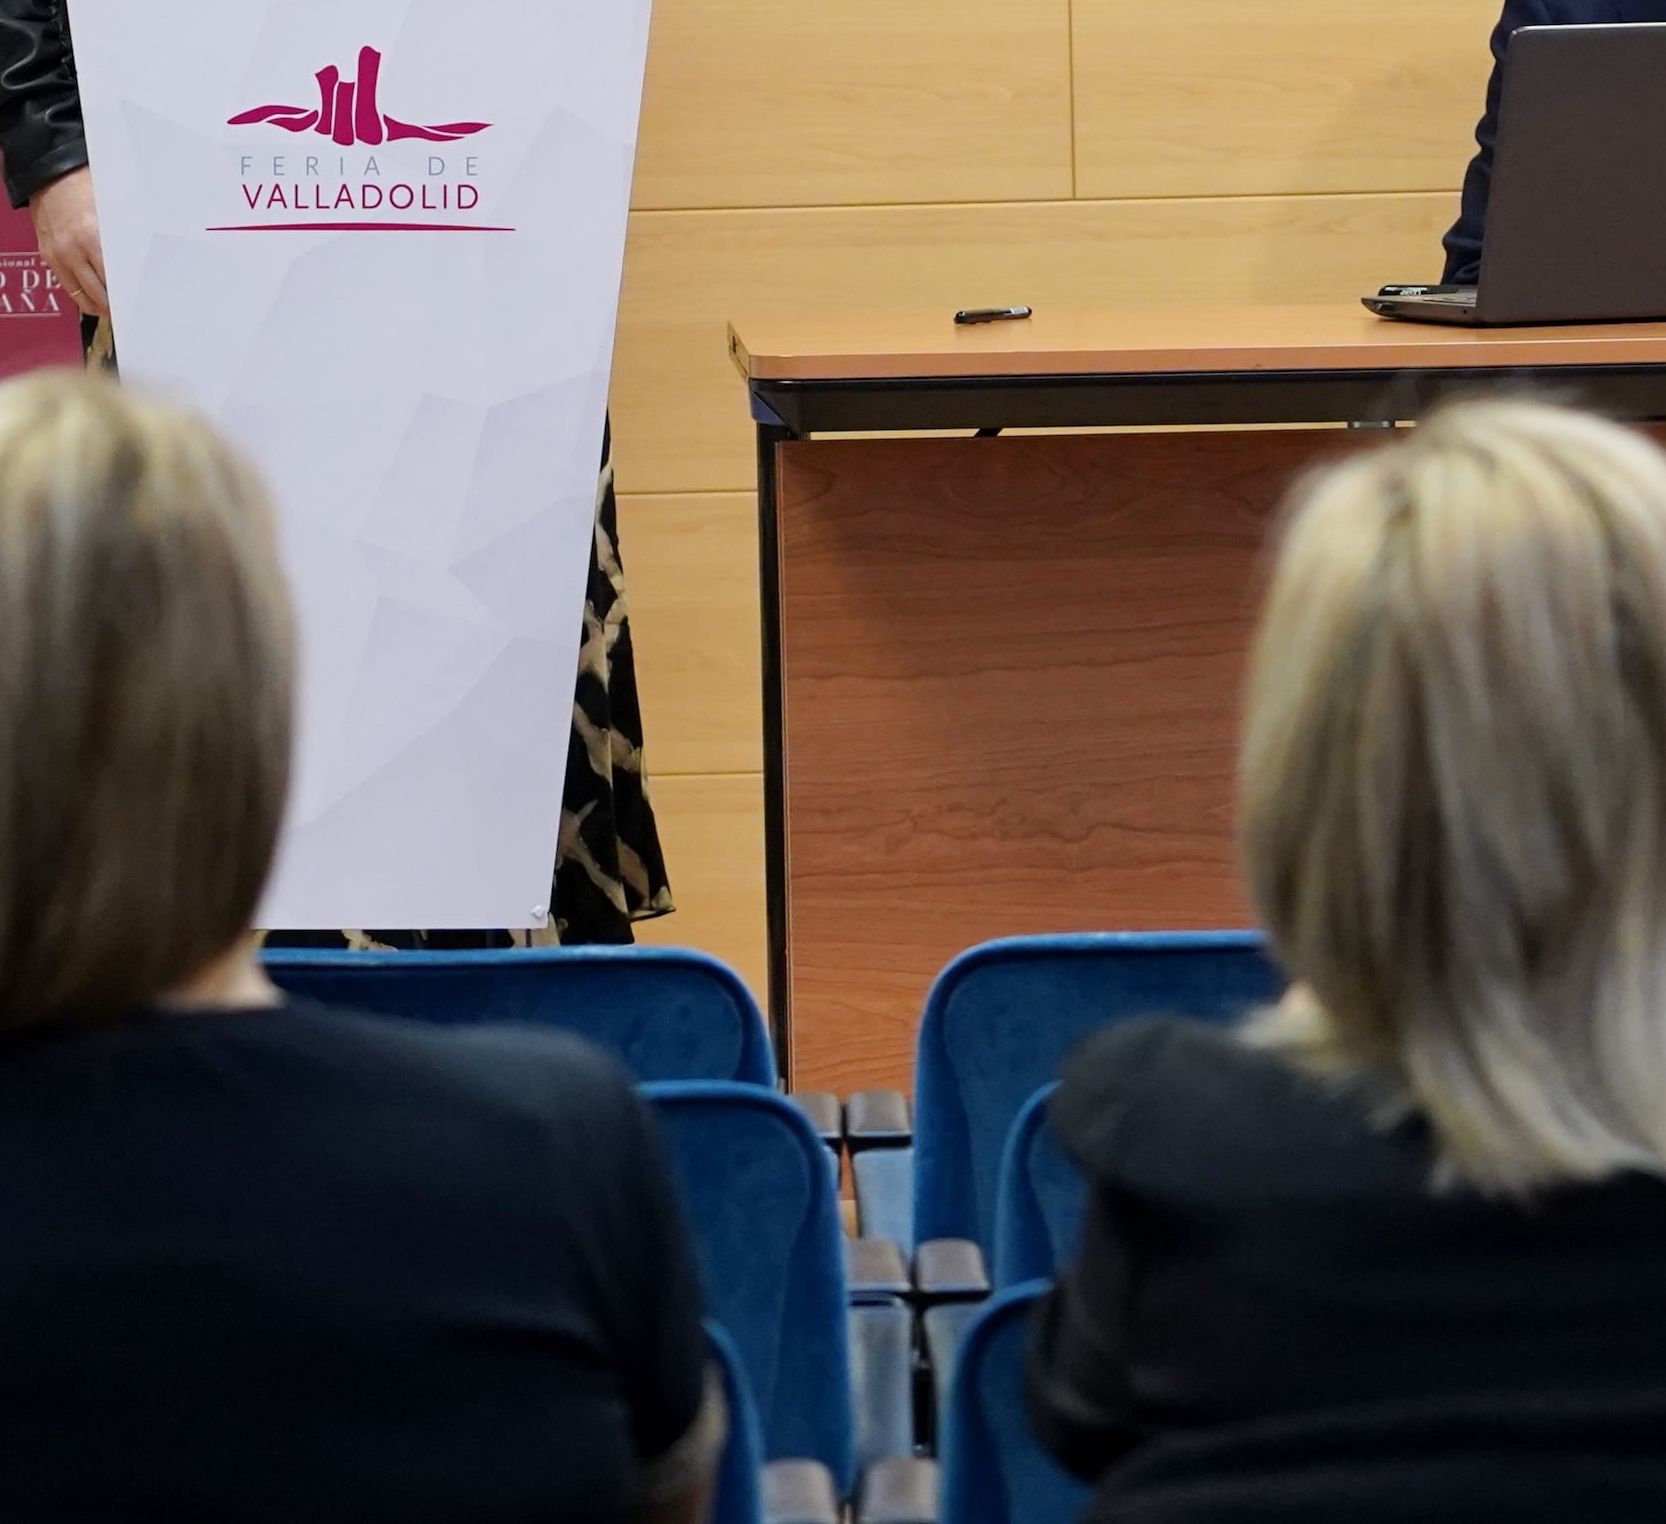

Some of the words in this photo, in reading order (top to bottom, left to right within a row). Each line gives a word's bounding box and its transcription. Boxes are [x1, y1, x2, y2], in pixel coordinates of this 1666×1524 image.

[240, 156, 381, 176] FERIA
[428, 155, 479, 176] DE
[242, 184, 479, 209] VALLADOLID
